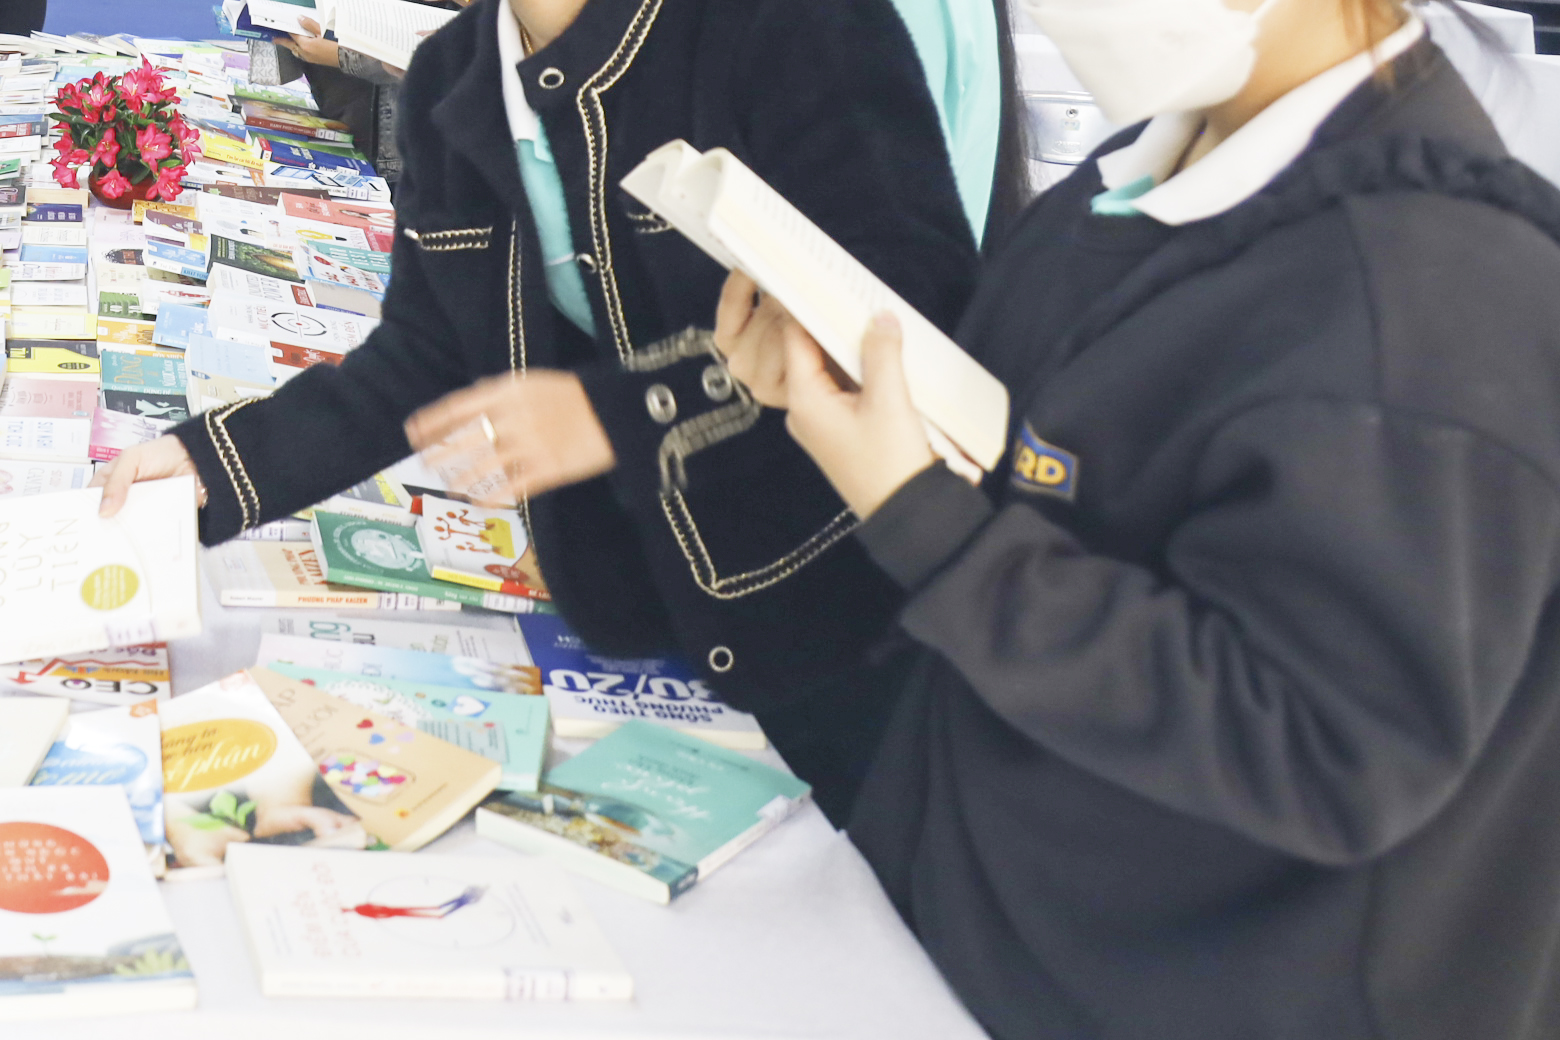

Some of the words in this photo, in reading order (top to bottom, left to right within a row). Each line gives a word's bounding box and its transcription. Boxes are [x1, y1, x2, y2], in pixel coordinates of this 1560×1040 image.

[257, 318, 270, 330] MỤC
[37, 421, 54, 434] SUY
[298, 595, 325, 604] PHƯƠNG
[326, 595, 344, 604] PHÁP
[345, 596, 368, 605] KAIZEN
[59, 677, 159, 696] CEO
